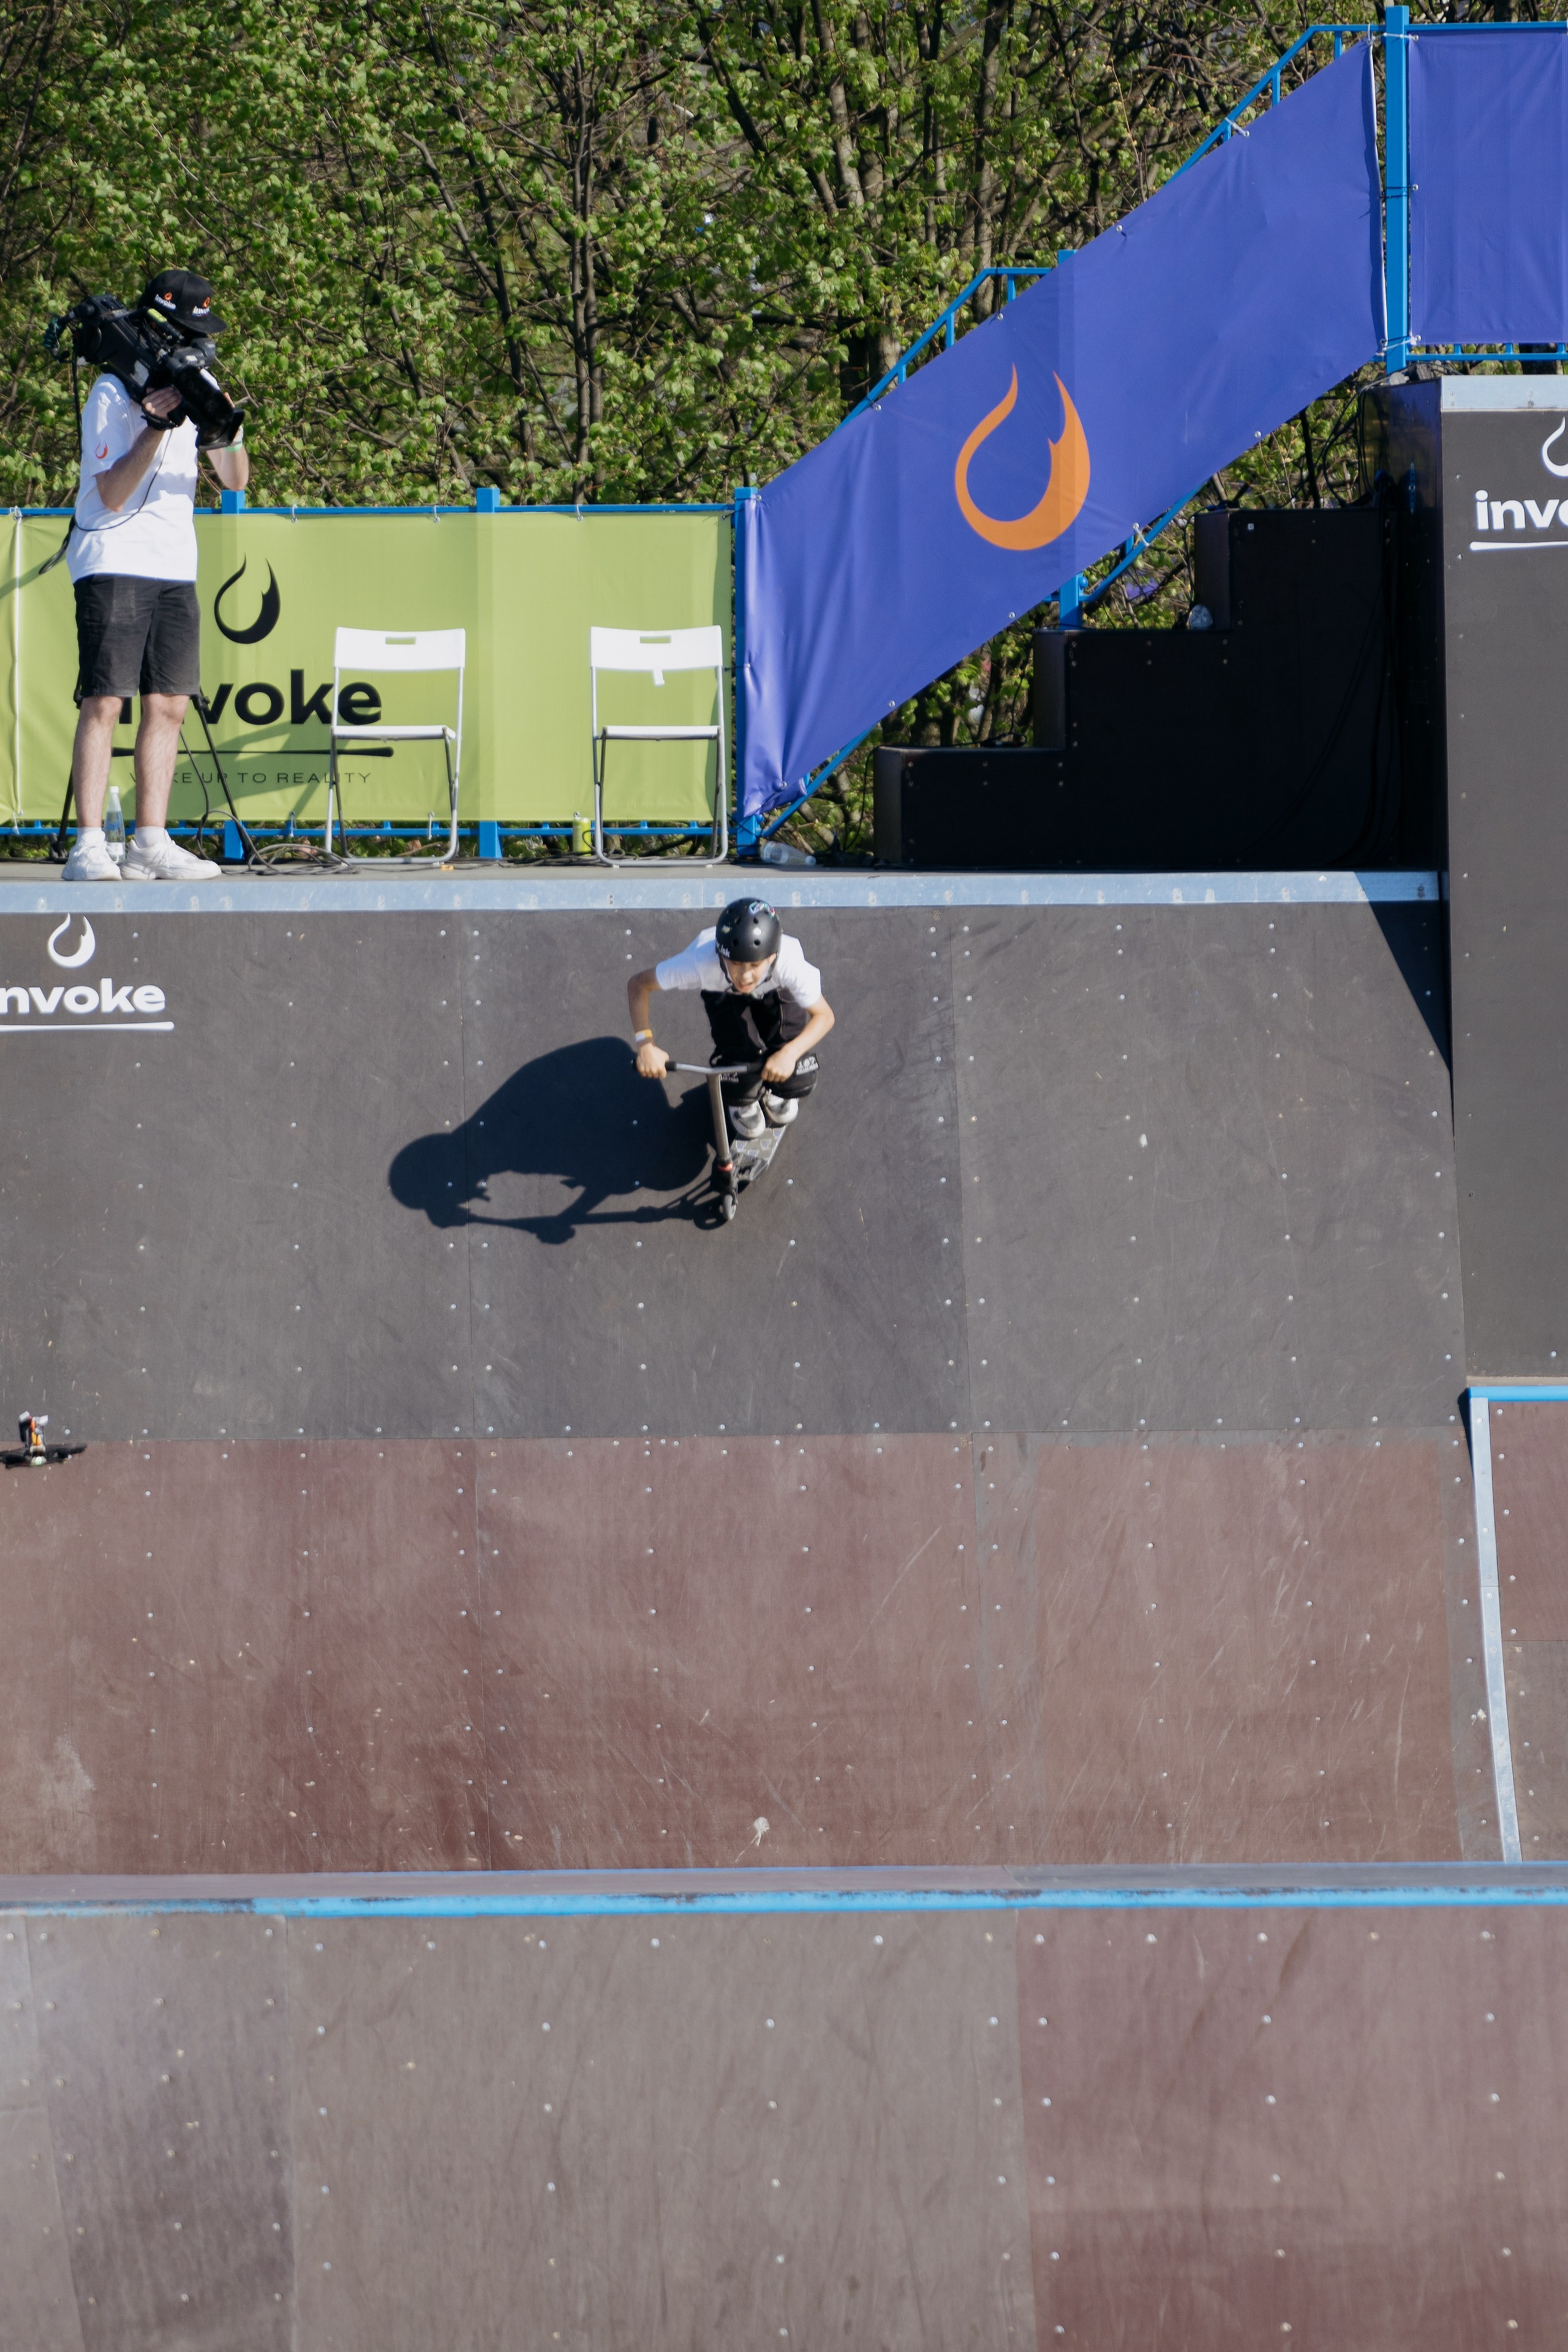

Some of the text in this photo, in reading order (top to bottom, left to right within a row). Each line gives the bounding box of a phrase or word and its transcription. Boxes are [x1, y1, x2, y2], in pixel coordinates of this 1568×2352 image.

[1475, 489, 1568, 530] inv
[119, 669, 382, 725] voke
[202, 772, 228, 783] UP
[237, 772, 266, 783] TO
